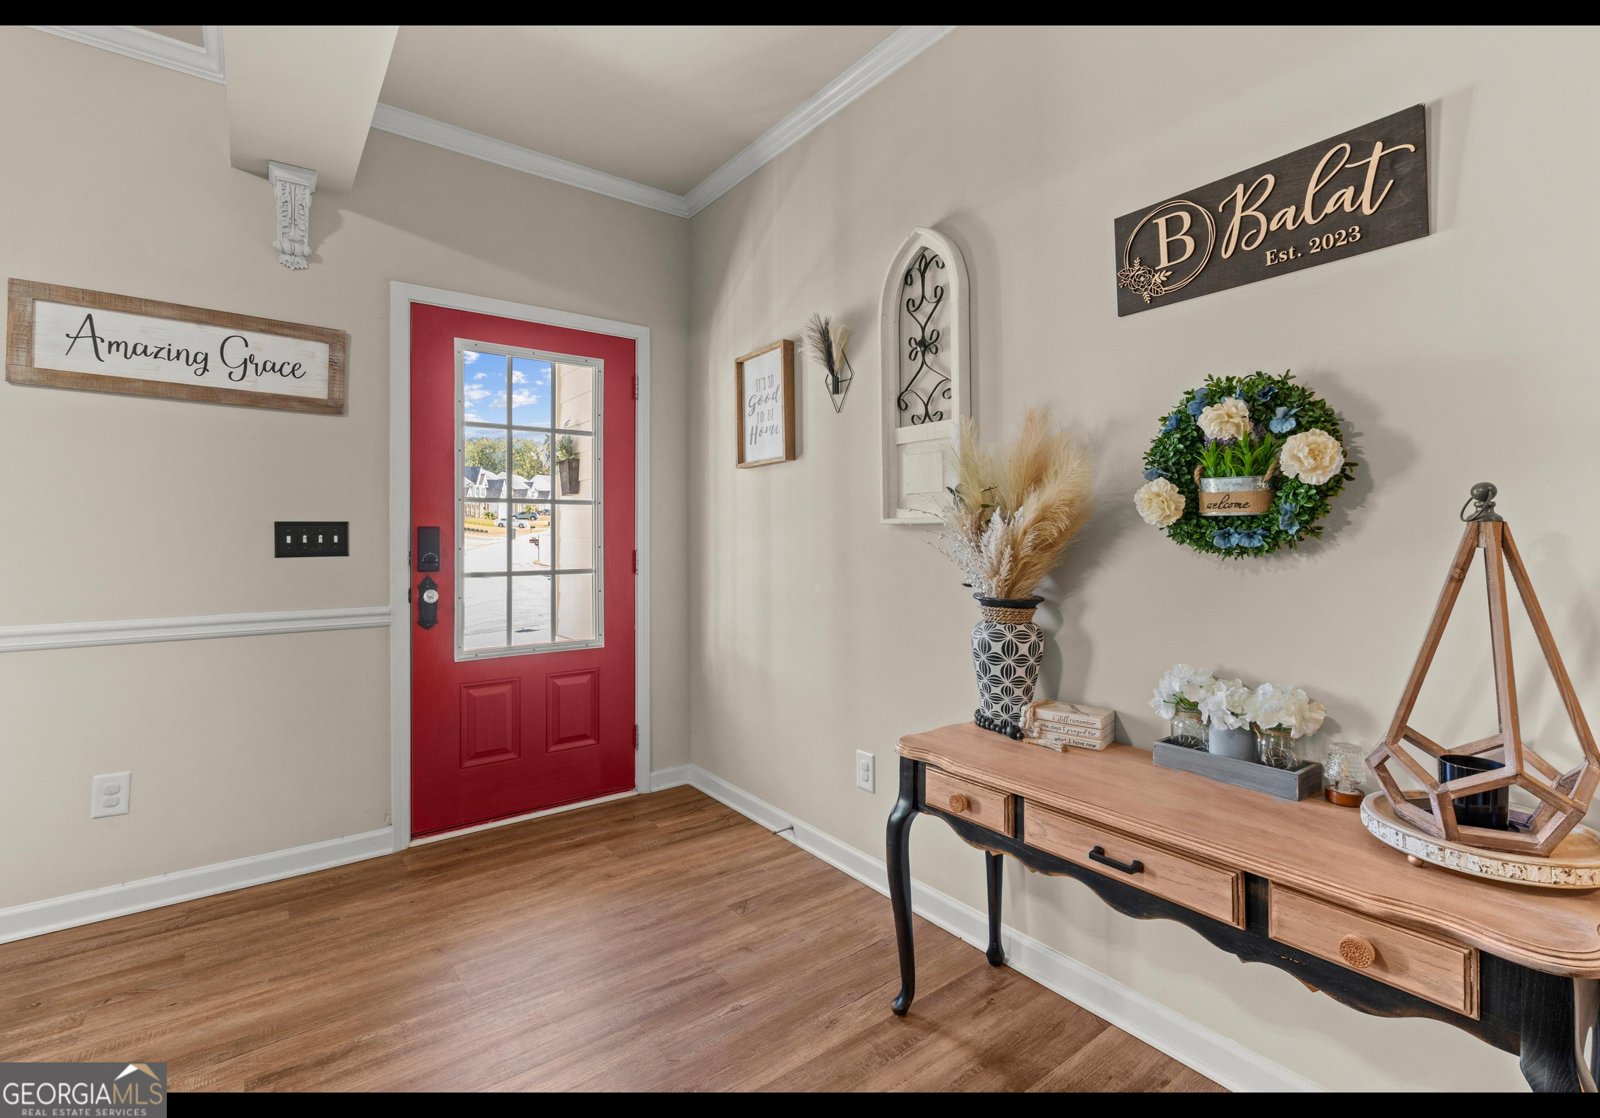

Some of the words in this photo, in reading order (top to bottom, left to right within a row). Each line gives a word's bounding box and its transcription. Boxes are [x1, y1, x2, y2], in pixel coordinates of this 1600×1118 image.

[1218, 141, 1416, 259] Balat
[1152, 211, 1196, 270] B
[1265, 250, 1302, 267] Est.
[1308, 225, 1362, 254] 2023
[65, 313, 210, 377] Amazing
[219, 335, 307, 382] Grace
[748, 384, 780, 417] Good
[749, 424, 779, 445] Home
[1206, 493, 1251, 510] welcome
